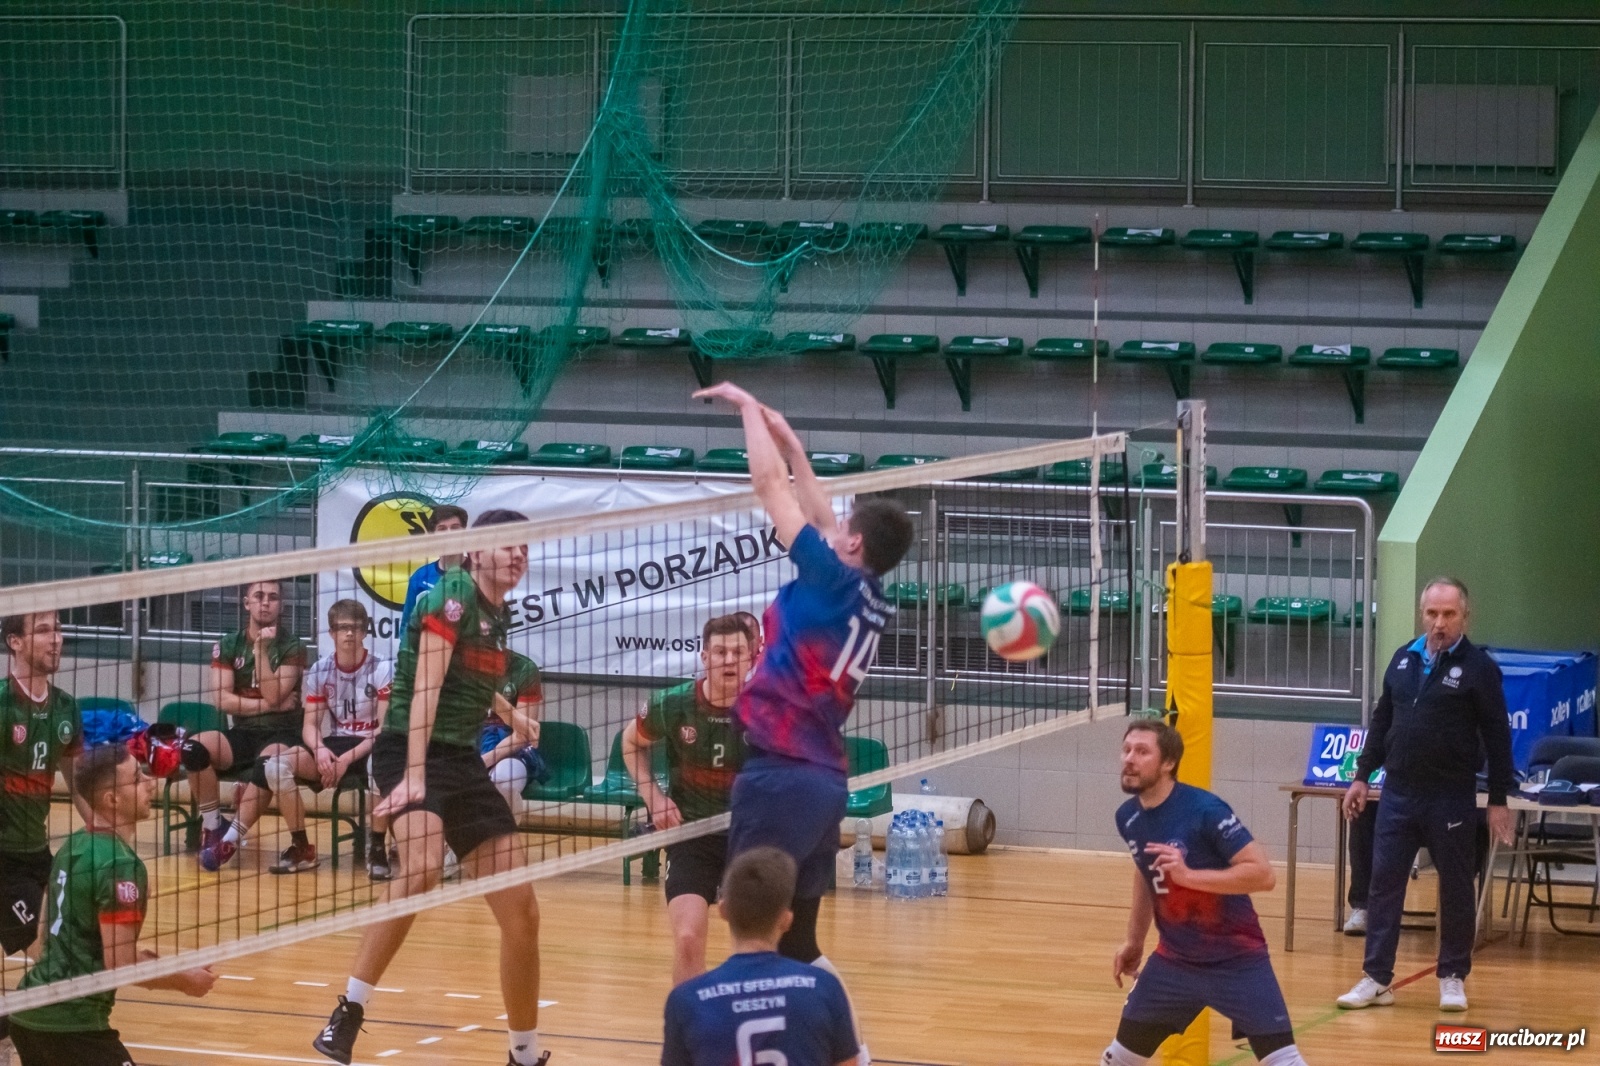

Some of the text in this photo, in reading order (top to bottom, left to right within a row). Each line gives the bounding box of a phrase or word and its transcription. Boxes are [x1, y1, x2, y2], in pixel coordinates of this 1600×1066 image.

[507, 527, 787, 629] EST W PORZĄDK
[615, 636, 702, 653] www.osi
[829, 615, 880, 695] 14
[343, 698, 357, 719] 14
[32, 741, 47, 770] 12
[712, 743, 725, 768] 2
[1320, 733, 1361, 760] 20 0
[1147, 865, 1170, 895] 2
[11, 899, 35, 925] 12
[696, 982, 741, 1001] TALENT
[732, 996, 787, 1014] CIESZYN
